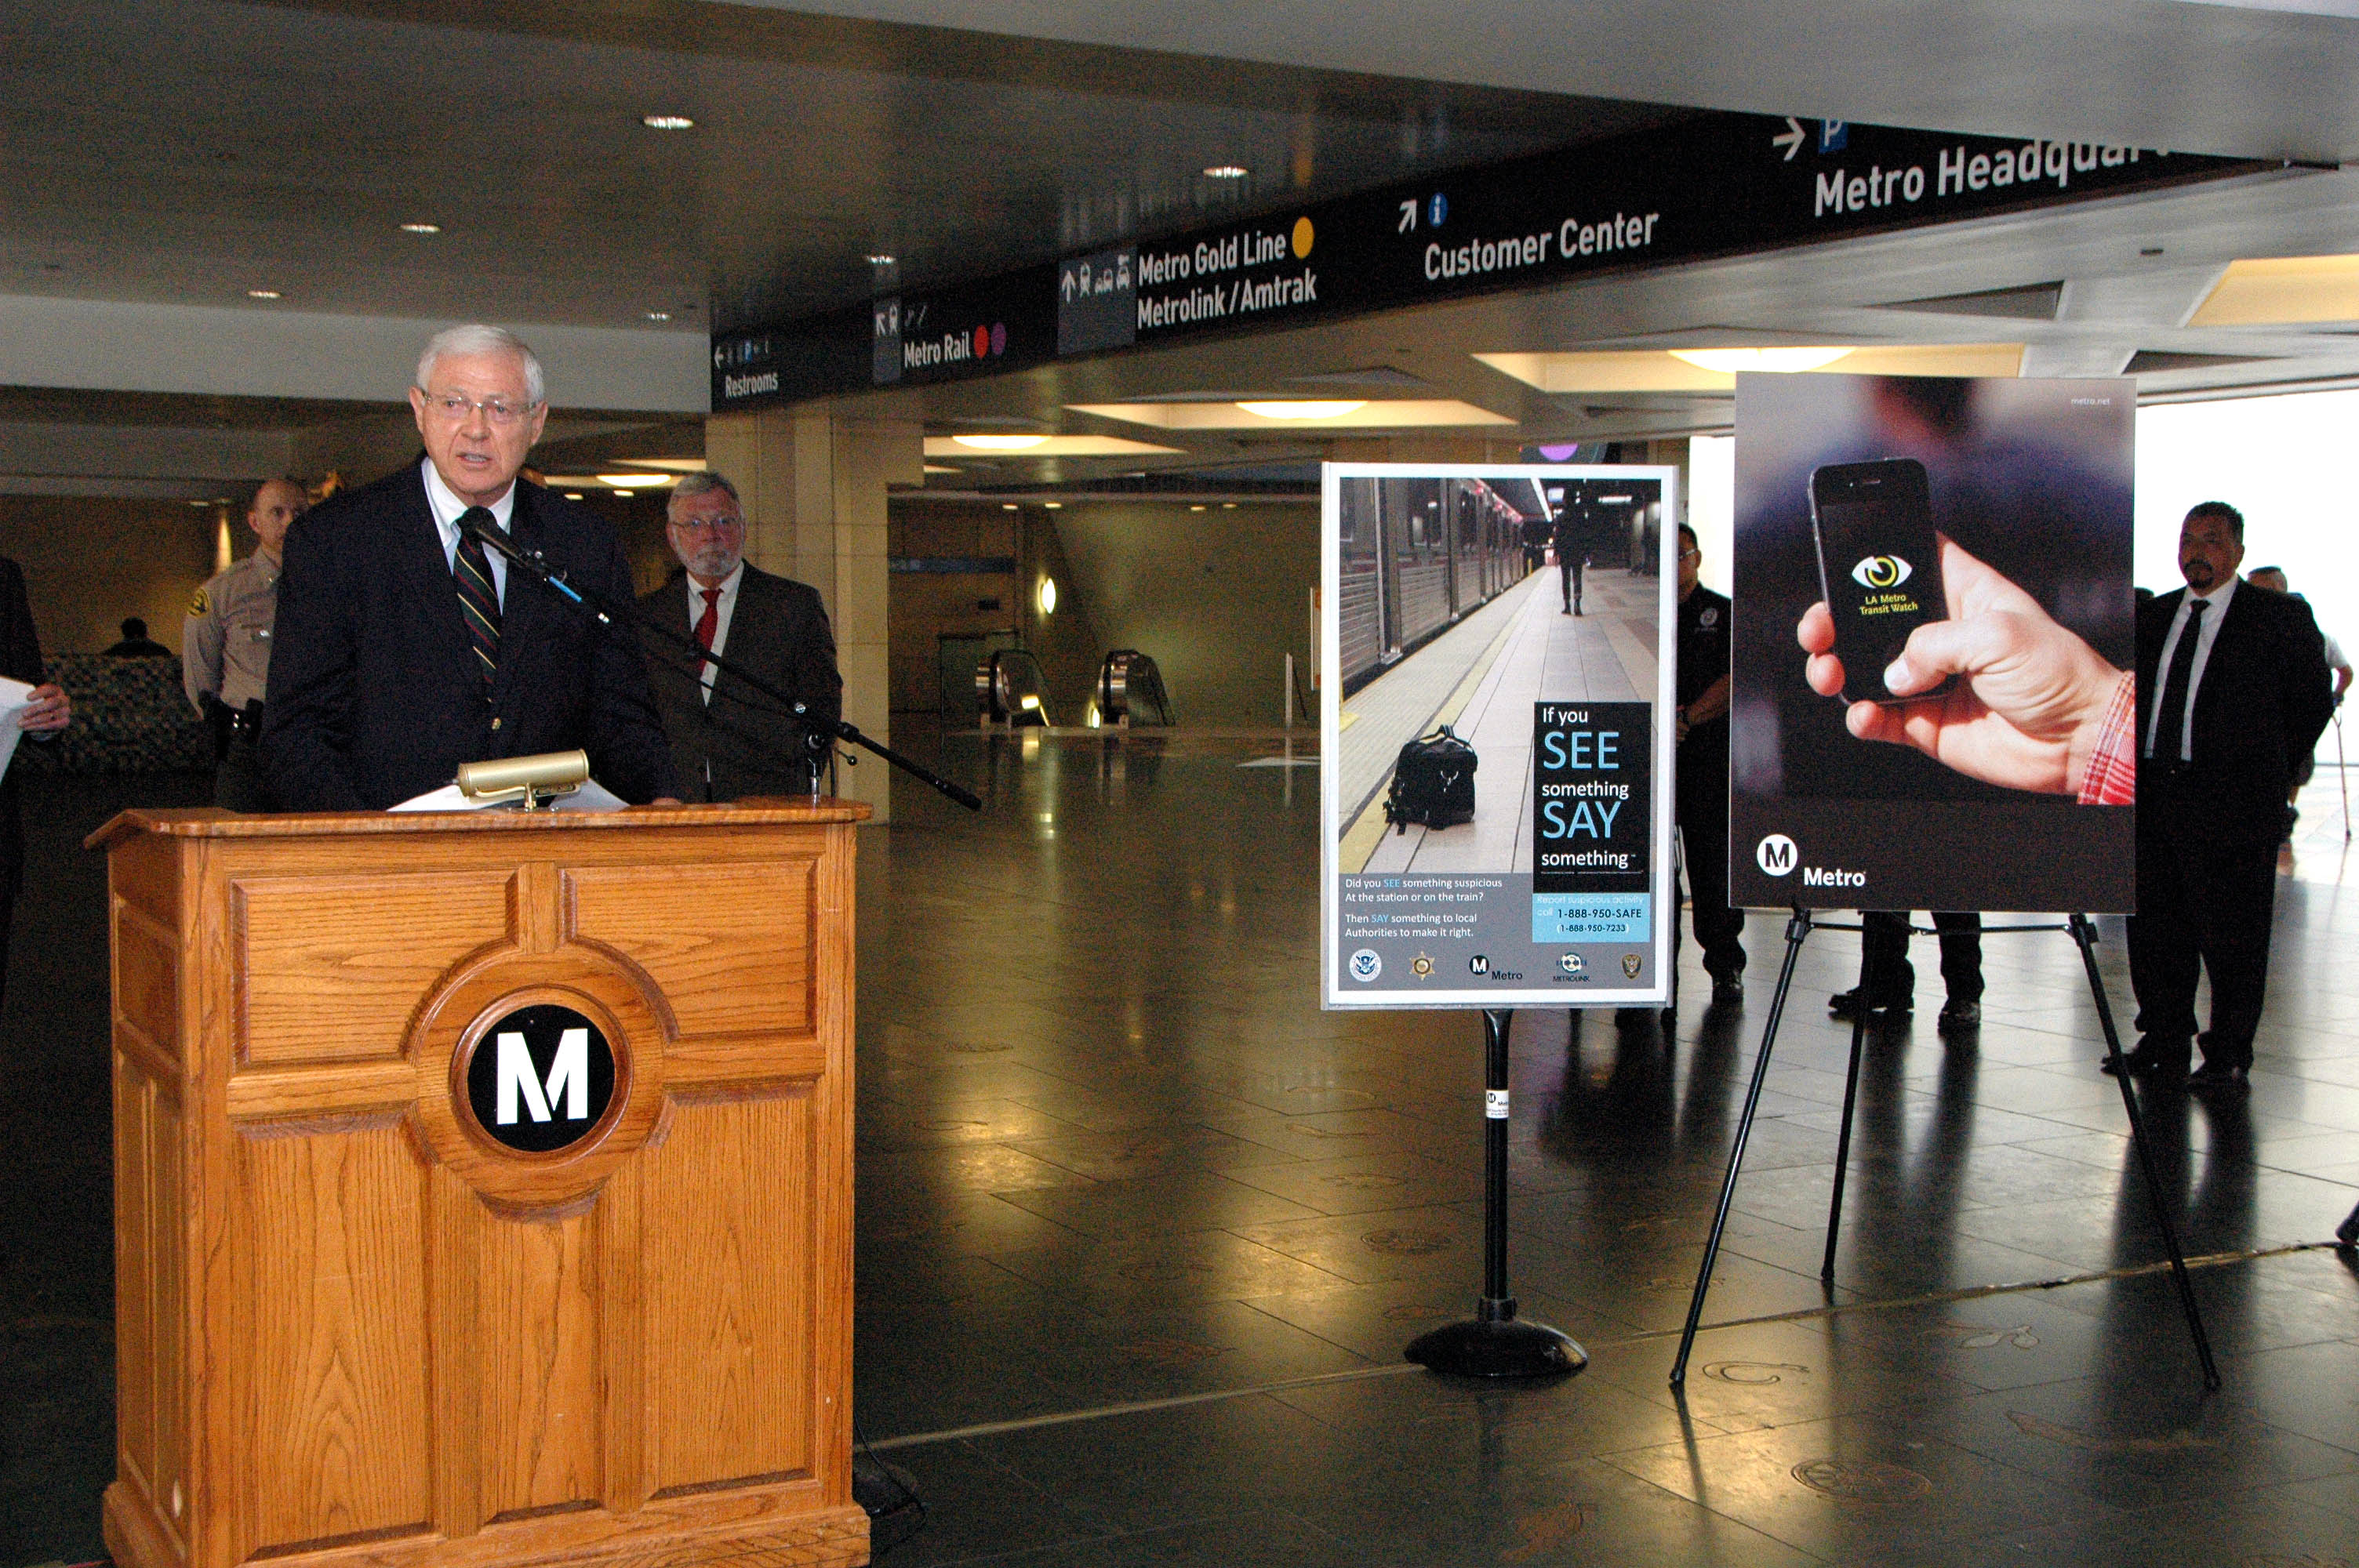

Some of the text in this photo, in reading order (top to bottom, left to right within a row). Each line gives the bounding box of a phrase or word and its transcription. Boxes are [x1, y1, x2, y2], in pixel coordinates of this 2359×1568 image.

[1815, 165, 1925, 218] Metro
[1424, 212, 1661, 281] Customer Center
[1138, 230, 1287, 287] Metro Gold Line
[904, 331, 971, 368] Metro Rail
[725, 372, 779, 399] Restrooms
[1859, 601, 1918, 615] Transit Watch
[1865, 594, 1906, 604] LA Metro
[1543, 706, 1588, 726] If you
[1543, 731, 1620, 770] SEE
[1542, 780, 1630, 800] something
[1543, 800, 1622, 839] SAY
[1541, 850, 1629, 869] something
[1765, 843, 1866, 887] M Metro
[1345, 877, 1503, 890] Did you SEE something suspicious
[1345, 892, 1484, 902] At the station or on the train?
[1537, 895, 1566, 905] Report
[1345, 913, 1477, 925] Then SAY something to local
[1558, 909, 1641, 918] 1-888-950-SAFE
[1345, 927, 1474, 939] Authorities to make it right.
[1556, 924, 1630, 935] (1-888-950-7233)
[1492, 970, 1523, 981] Metro
[496, 1028, 588, 1125] M
